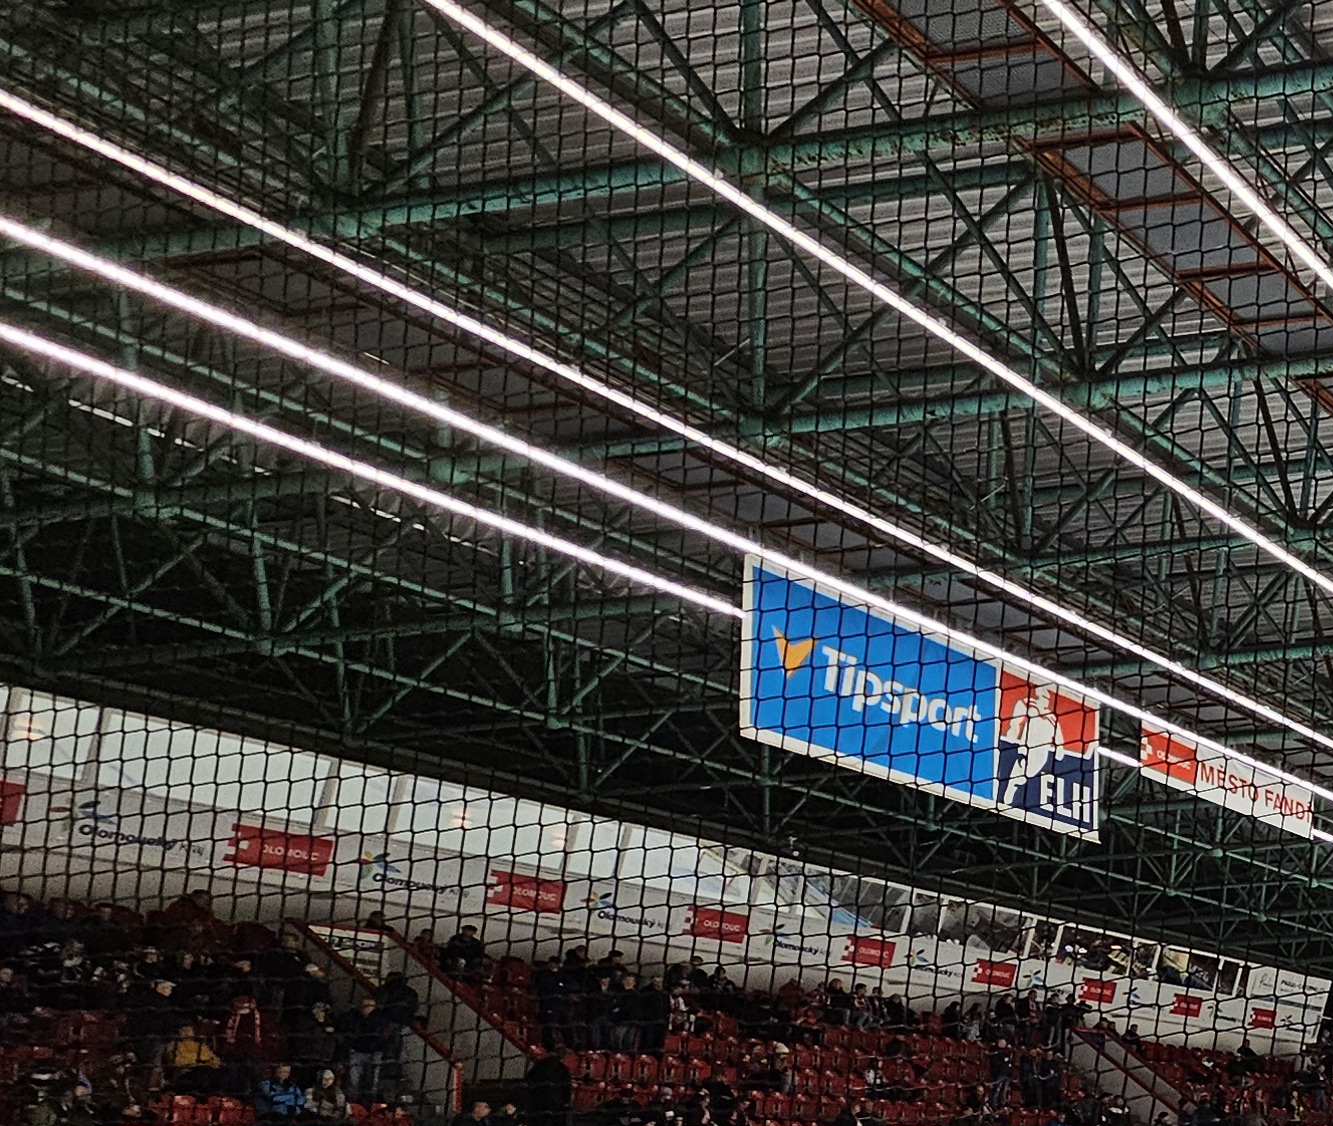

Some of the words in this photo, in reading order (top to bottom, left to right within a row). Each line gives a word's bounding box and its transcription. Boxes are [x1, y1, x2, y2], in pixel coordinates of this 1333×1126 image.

[823, 646, 981, 744] Tipsport
[1040, 771, 1091, 823] ELH
[1200, 758, 1259, 801] MĚSTO
